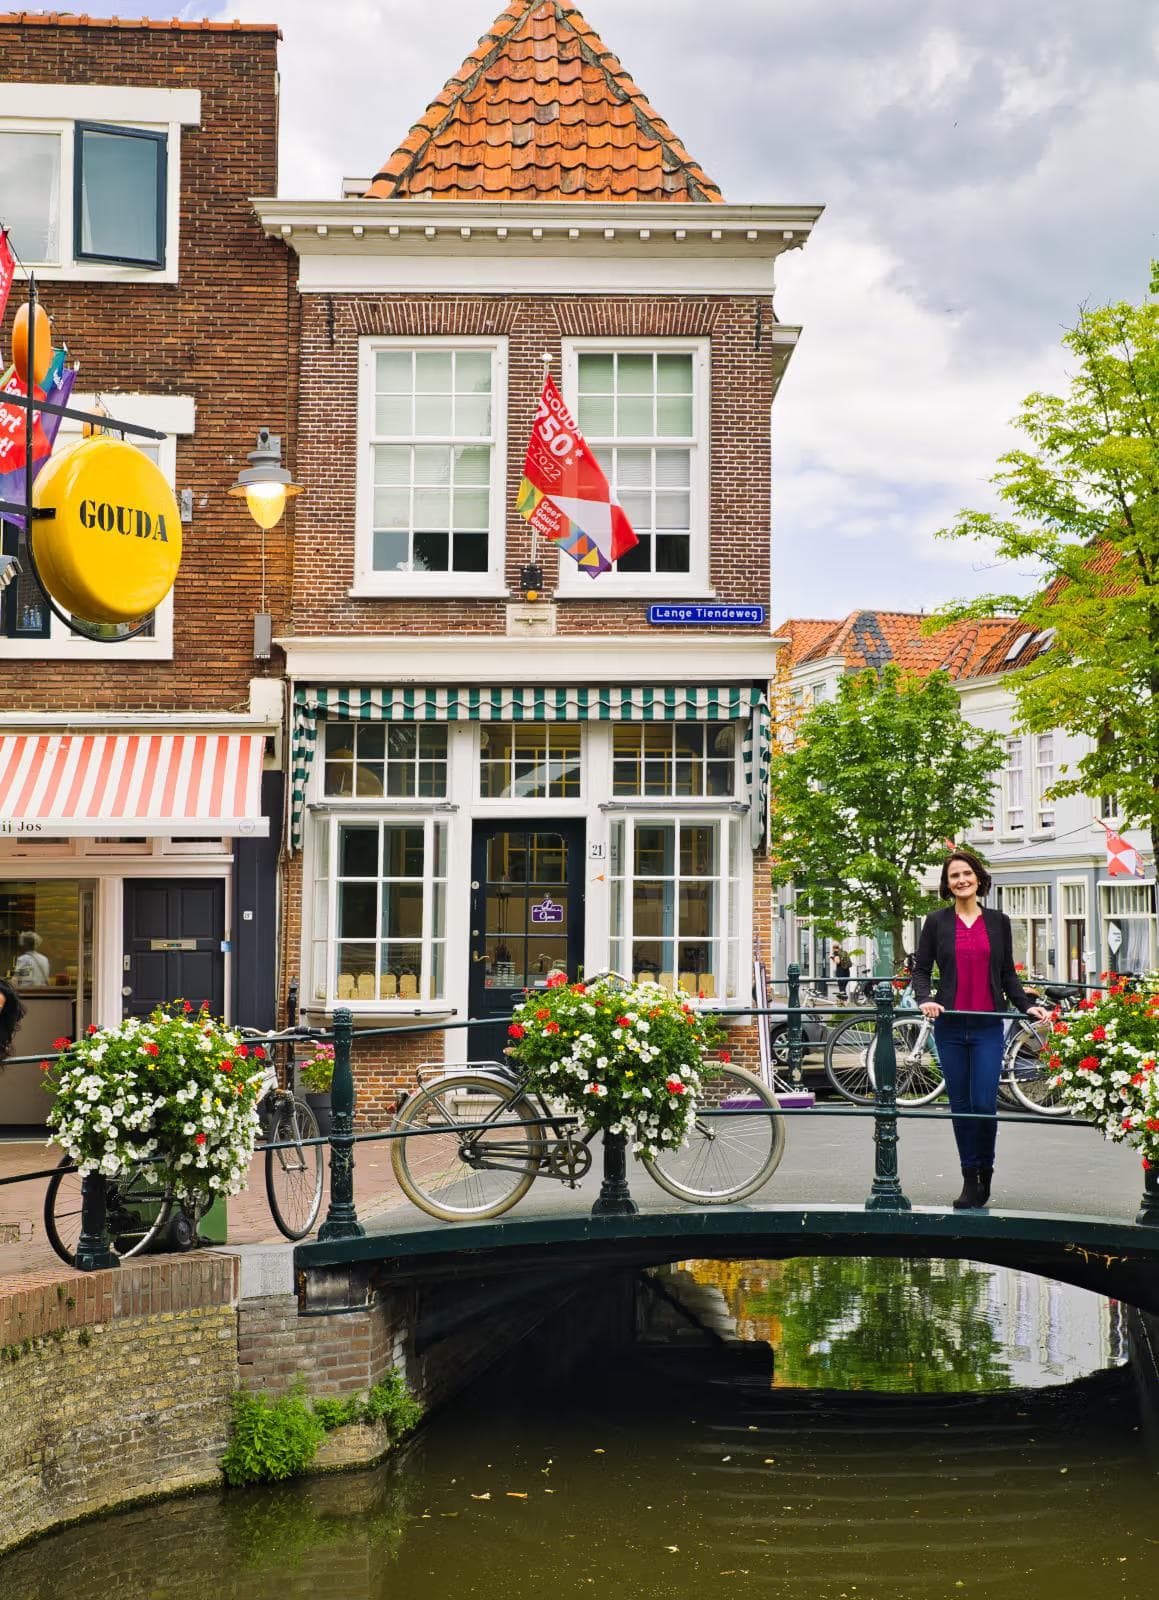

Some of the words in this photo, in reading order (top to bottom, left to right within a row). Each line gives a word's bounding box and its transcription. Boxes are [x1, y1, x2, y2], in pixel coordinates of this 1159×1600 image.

[0, 408, 22, 433] ert
[545, 389, 583, 440] GOUDA
[533, 447, 561, 481] 2022
[79, 499, 169, 543] GOUDA
[536, 508, 560, 531] Gouda
[541, 501, 562, 519] Geef
[656, 608, 692, 620] Lange
[696, 608, 758, 620] Tiendeweg
[2, 820, 12, 834] ij
[17, 821, 42, 832] Jos
[592, 844, 602, 857] 21
